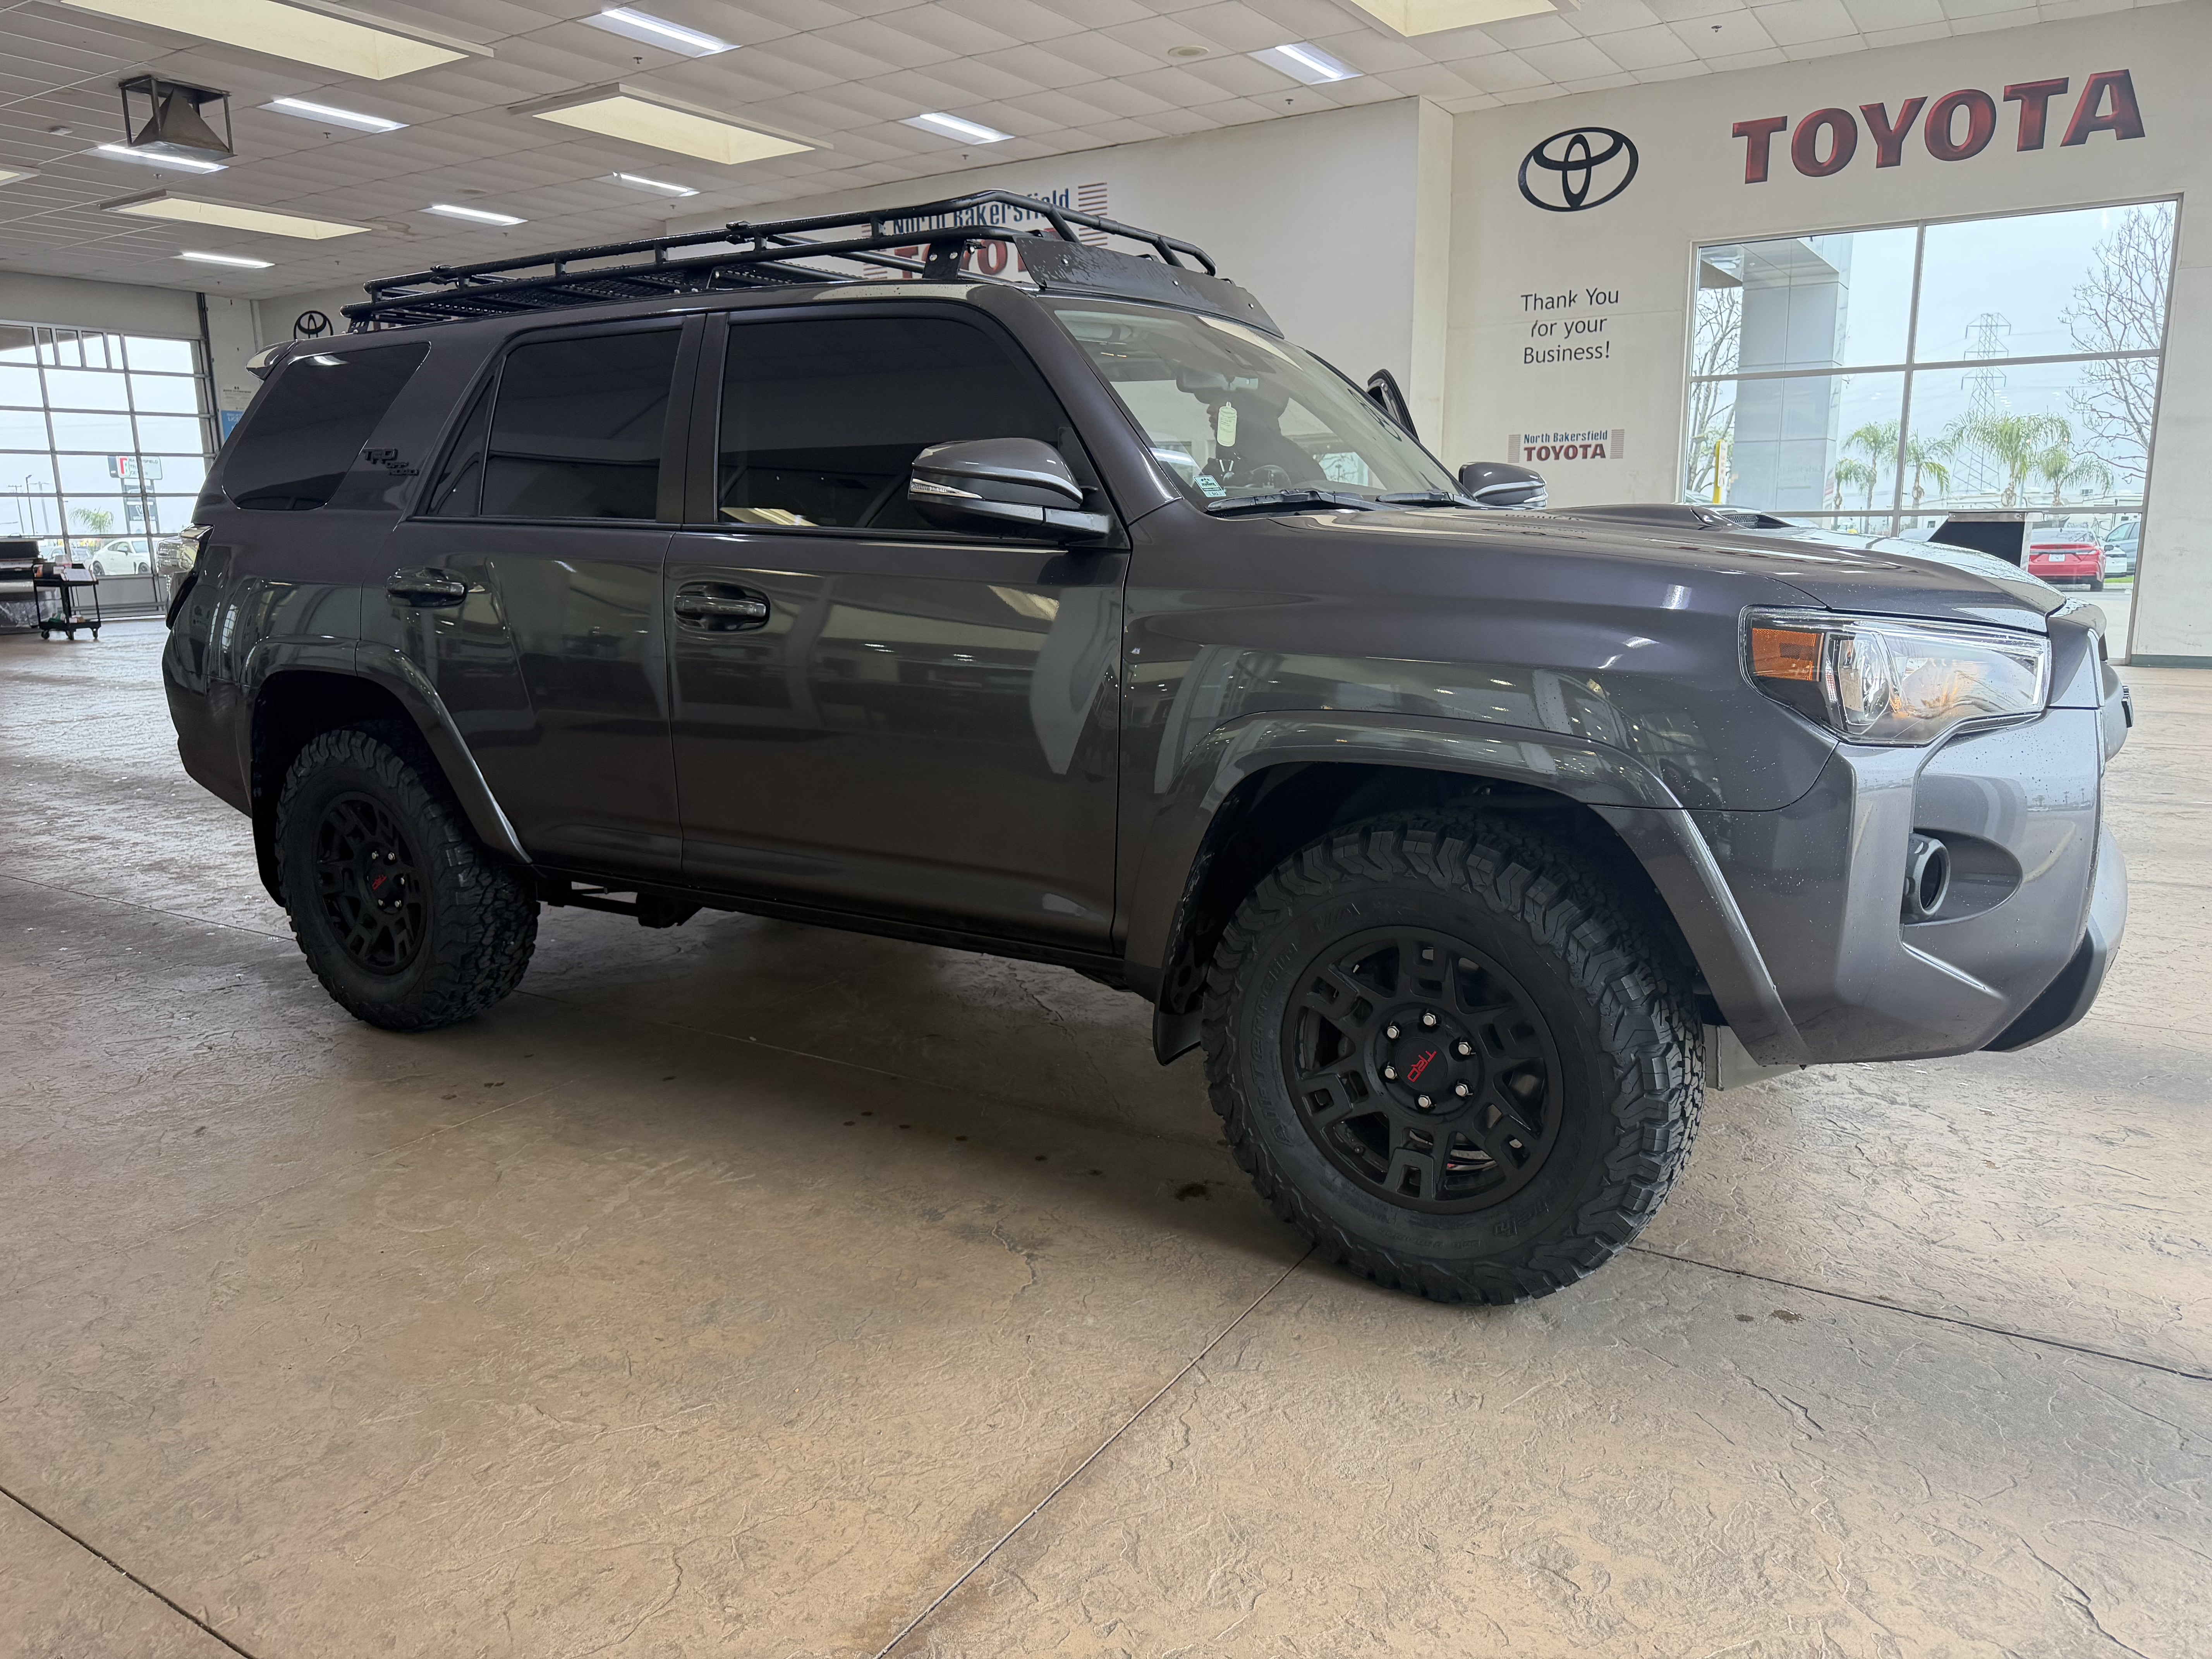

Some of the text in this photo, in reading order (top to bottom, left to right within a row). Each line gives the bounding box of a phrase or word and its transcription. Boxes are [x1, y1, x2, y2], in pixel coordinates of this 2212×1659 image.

[1732, 69, 2146, 184] TOYOTA
[1521, 287, 1619, 311] Thank You
[1564, 318, 1607, 339] your
[1524, 341, 1609, 364] Business!
[1524, 430, 1607, 444] North Bakersfield
[1523, 443, 1606, 462] TOYOTA
[1407, 1051, 1437, 1082] TRD
